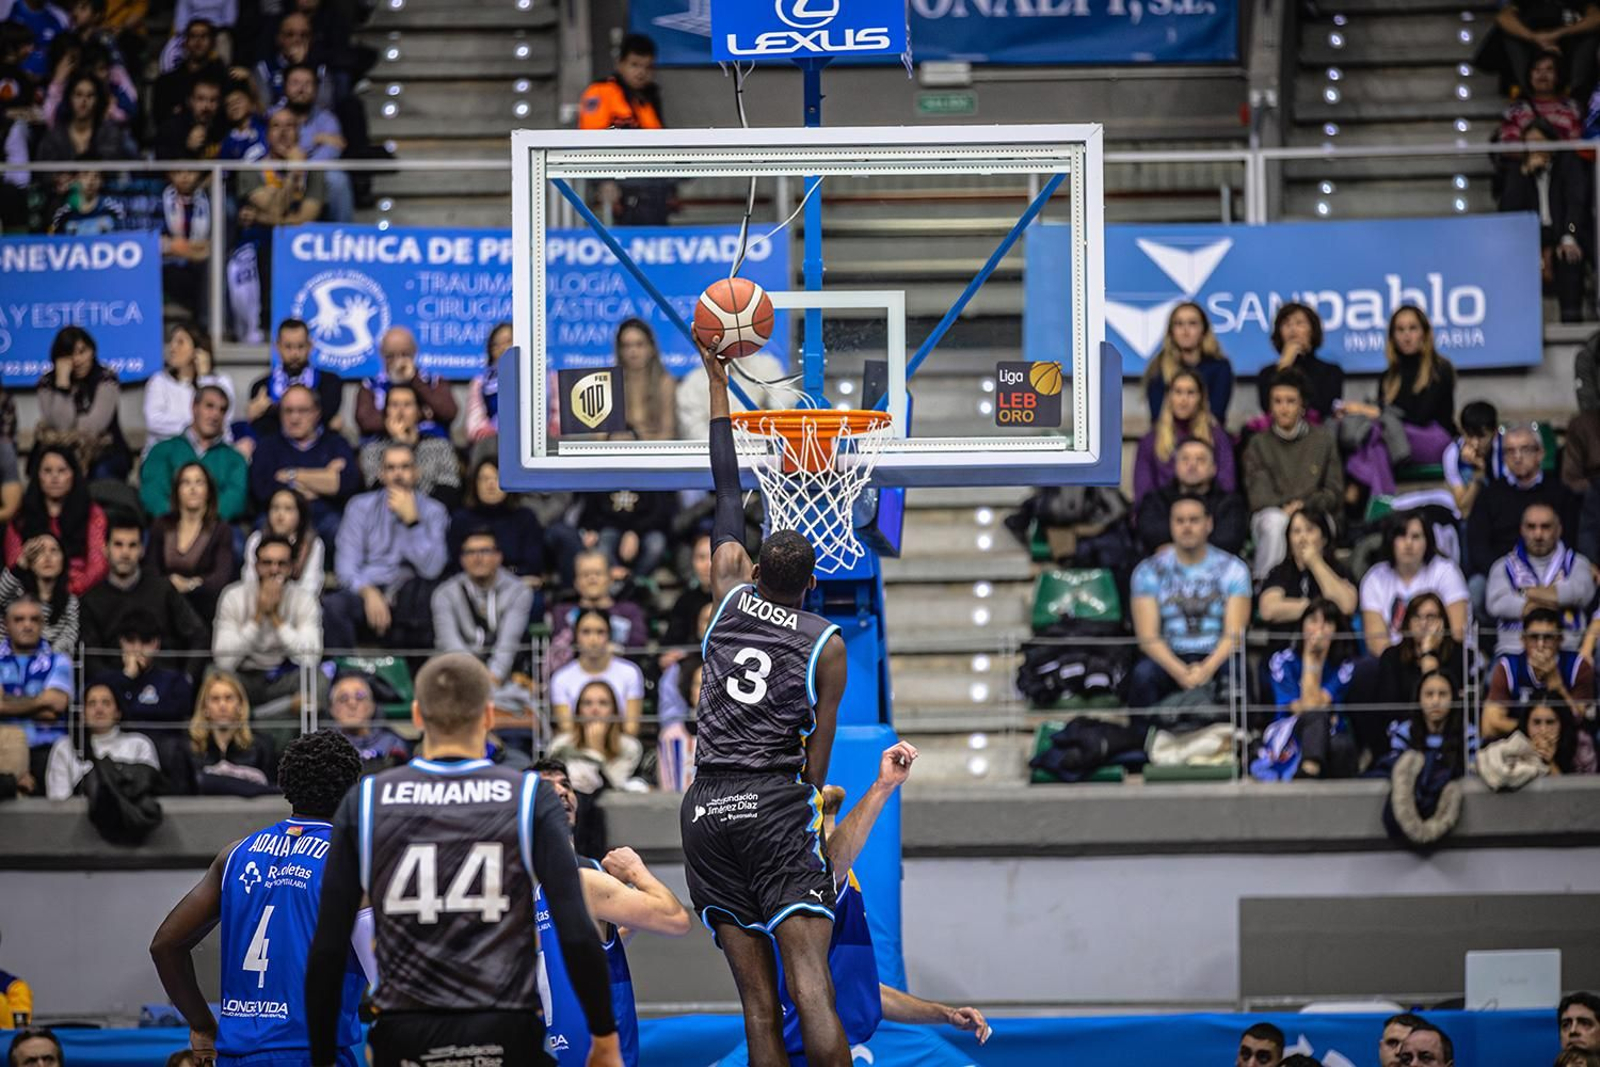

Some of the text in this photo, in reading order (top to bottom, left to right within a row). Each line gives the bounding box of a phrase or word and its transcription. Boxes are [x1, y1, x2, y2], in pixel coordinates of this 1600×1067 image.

[727, 27, 890, 55] LEXUS
[0, 241, 143, 272] NEVADO
[291, 229, 422, 264] CLÍNICA
[427, 236, 474, 265] DE
[416, 270, 628, 297] TRAUMALOGÍA
[31, 299, 144, 328] ESTÉTICA
[999, 369, 1024, 385] Liga
[579, 384, 604, 418] 100
[999, 392, 1037, 409] LEB
[998, 409, 1035, 423] ORO
[737, 591, 798, 630] NZOSA
[726, 647, 772, 704] 3
[381, 779, 512, 804] LEIMANIS
[383, 842, 511, 924] 44
[242, 905, 275, 989] 4
